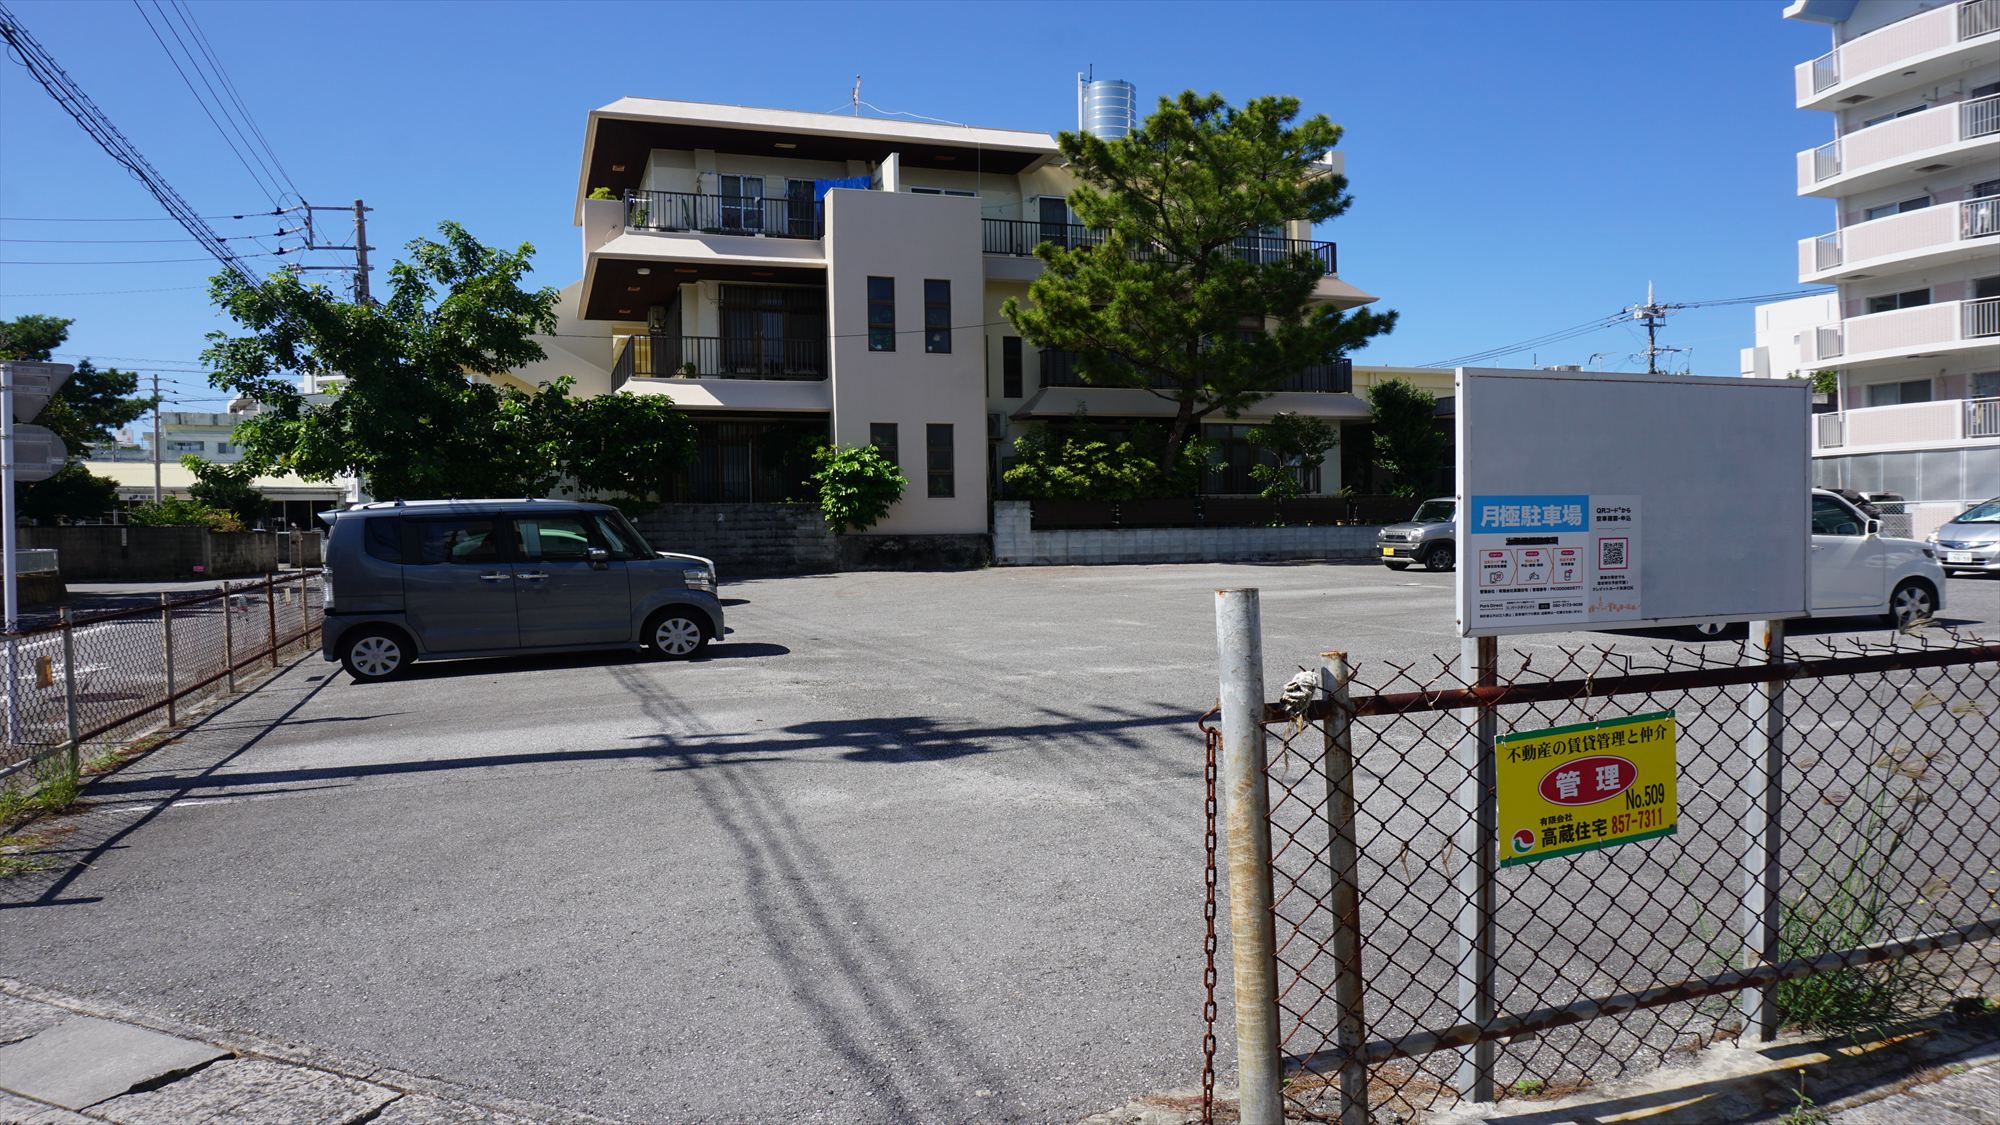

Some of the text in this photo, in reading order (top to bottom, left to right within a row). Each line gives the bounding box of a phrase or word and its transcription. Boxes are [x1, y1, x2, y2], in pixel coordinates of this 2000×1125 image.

[1480, 504, 1583, 528] 月極駐車場
[1507, 724, 1667, 764] 不動産の賃貸管理と仲介
[1555, 764, 1621, 800] 管理
[1625, 782, 1665, 811] No.509
[1539, 813, 1573, 826] 有限会社
[1541, 807, 1663, 848] 高蔵住宅 857-7311
